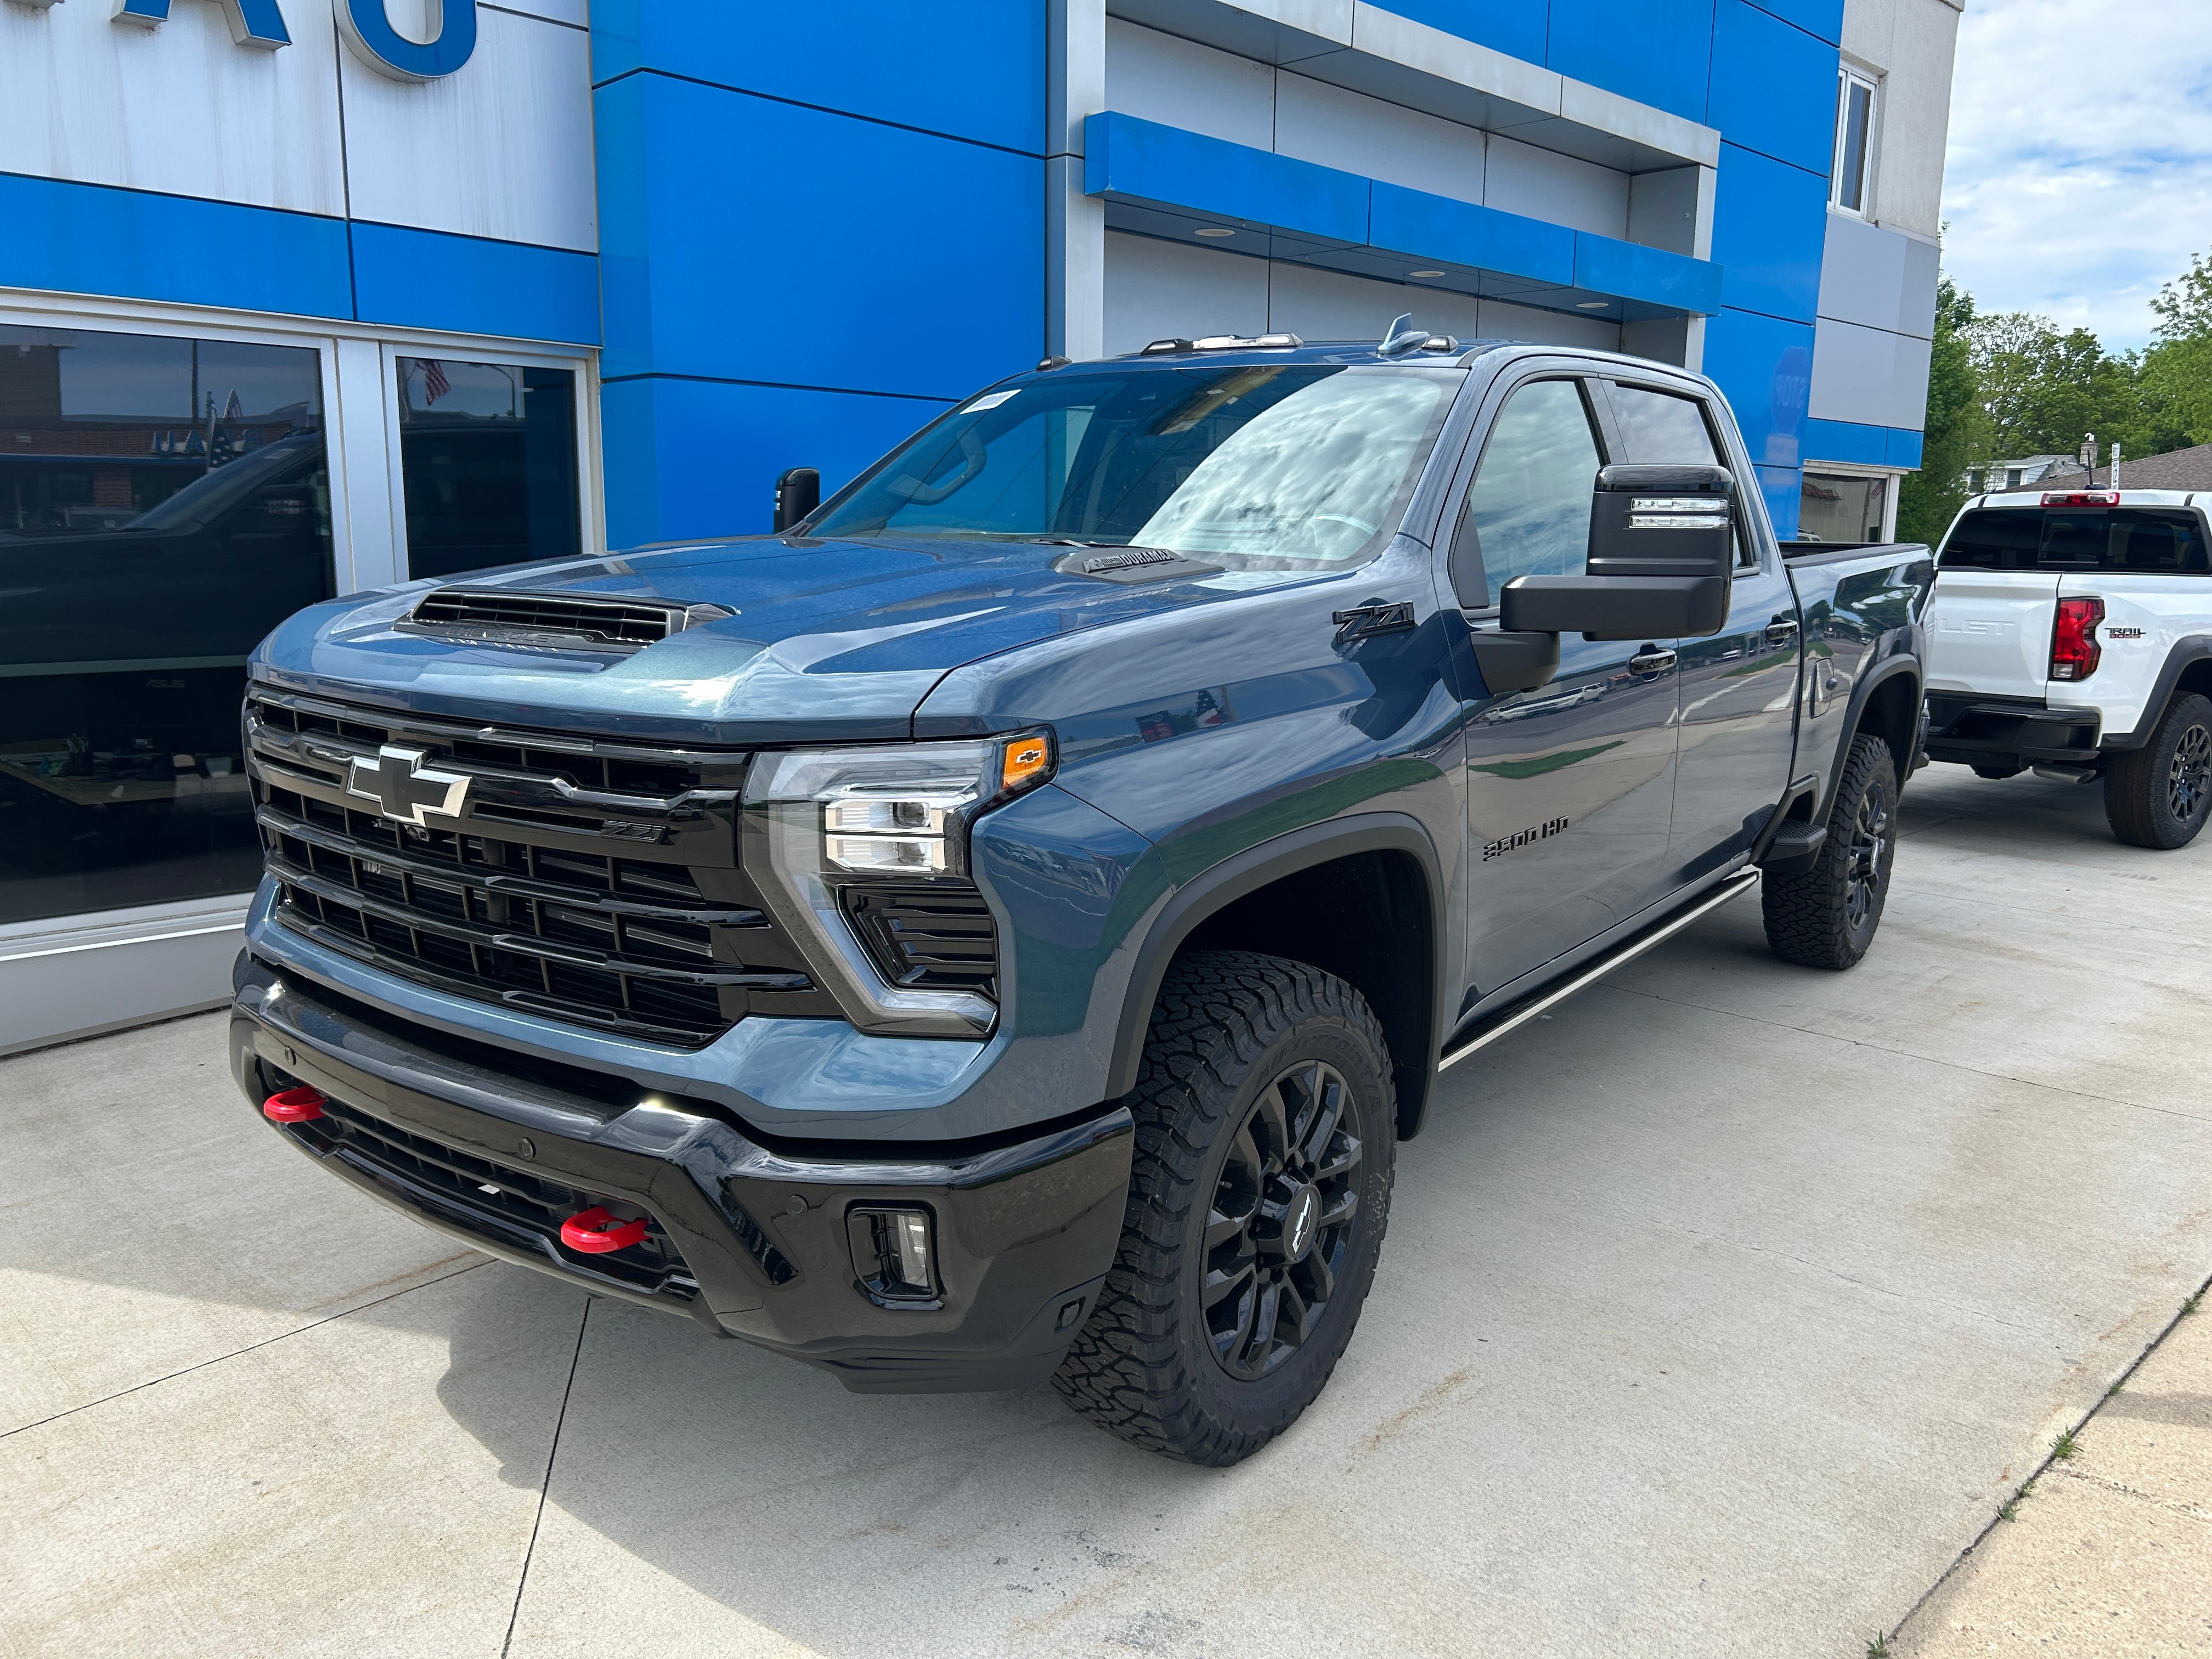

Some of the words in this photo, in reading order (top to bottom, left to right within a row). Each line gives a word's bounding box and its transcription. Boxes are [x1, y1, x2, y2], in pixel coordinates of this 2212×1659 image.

[1120, 549, 1175, 566] DURAMAX
[1332, 600, 1415, 644] Z71
[446, 626, 566, 645] CHEVROLET
[145, 679, 186, 689] ASUS
[1542, 815, 1569, 838] HD
